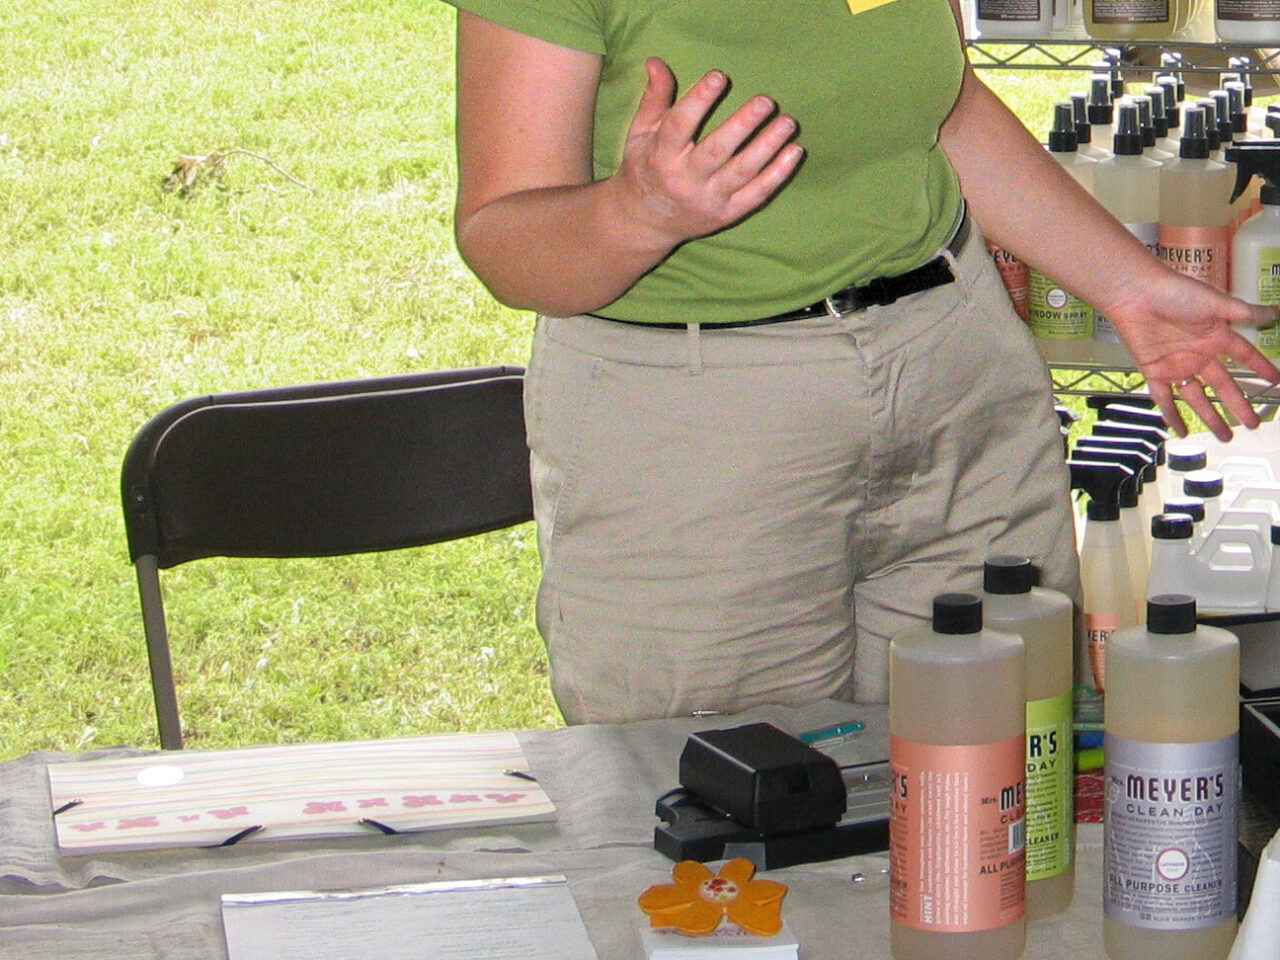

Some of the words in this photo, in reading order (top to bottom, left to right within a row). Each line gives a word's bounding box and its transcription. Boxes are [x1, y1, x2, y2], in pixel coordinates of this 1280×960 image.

[1027, 760, 1057, 773] DAY
[1126, 773, 1224, 803] MEYER'S
[1126, 803, 1184, 817] CLEAN
[1194, 802, 1224, 816] DAY
[979, 863, 998, 876] ALL
[1126, 879, 1180, 893] PURPOSE
[1184, 879, 1223, 893] CLEANER
[923, 895, 933, 924] HINT
[1139, 912, 1152, 921] 32
